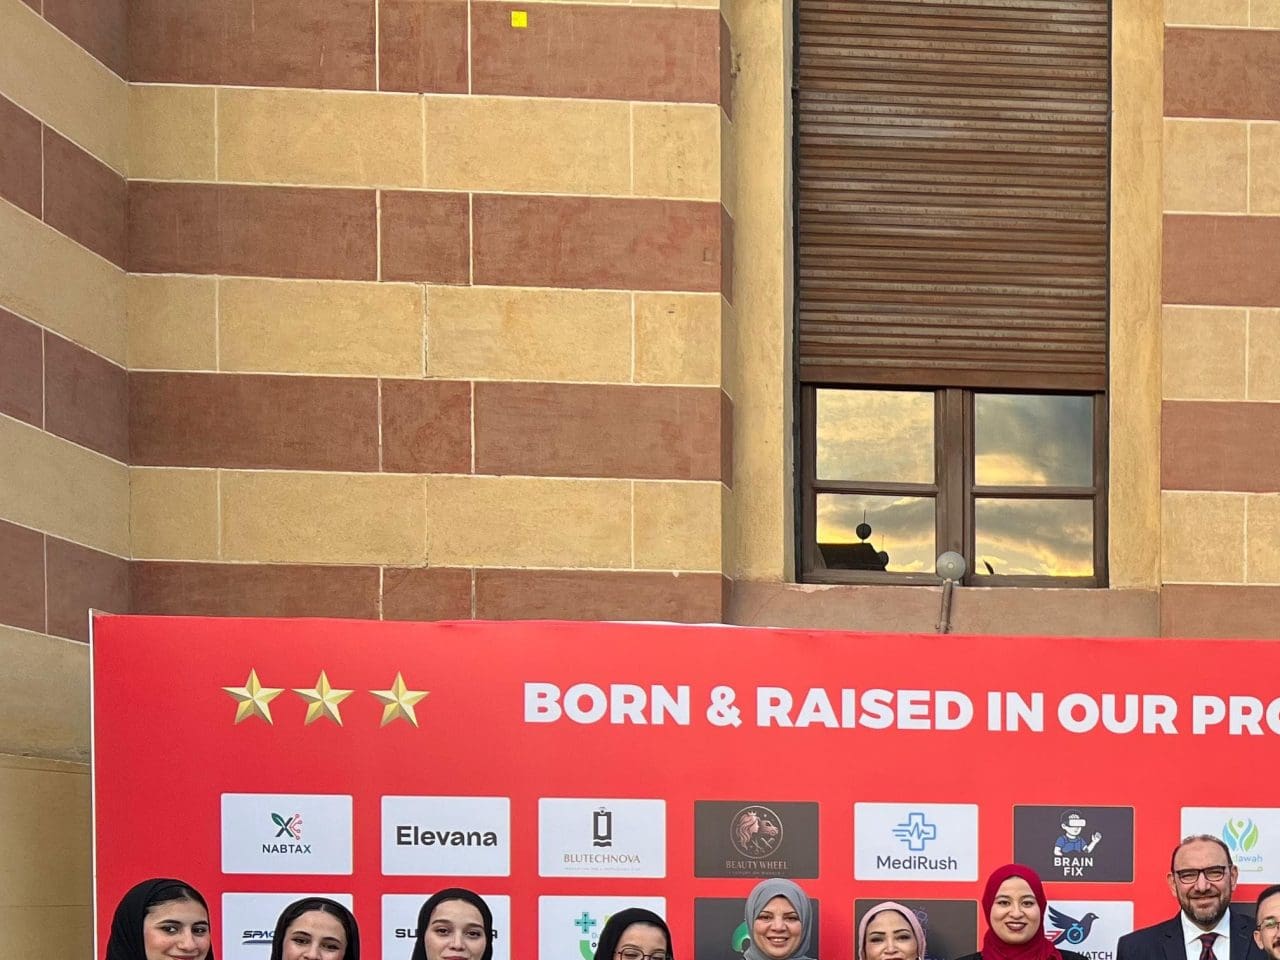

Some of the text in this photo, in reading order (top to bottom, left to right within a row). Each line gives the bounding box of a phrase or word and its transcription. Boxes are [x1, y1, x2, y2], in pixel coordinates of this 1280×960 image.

[524, 682, 691, 726] BORN
[706, 685, 743, 728] &
[756, 686, 974, 731] RAISED
[987, 691, 1044, 733] IN
[1057, 693, 1178, 735] OUR
[396, 825, 498, 847] Elevana
[262, 844, 312, 854] NABTAX
[563, 853, 642, 864] BLUTECHNOVA
[876, 855, 958, 870] MediRush
[1053, 857, 1094, 867] BRAIN
[725, 860, 789, 870] BEAUTY WHEEL
[1063, 867, 1084, 876] FIX
